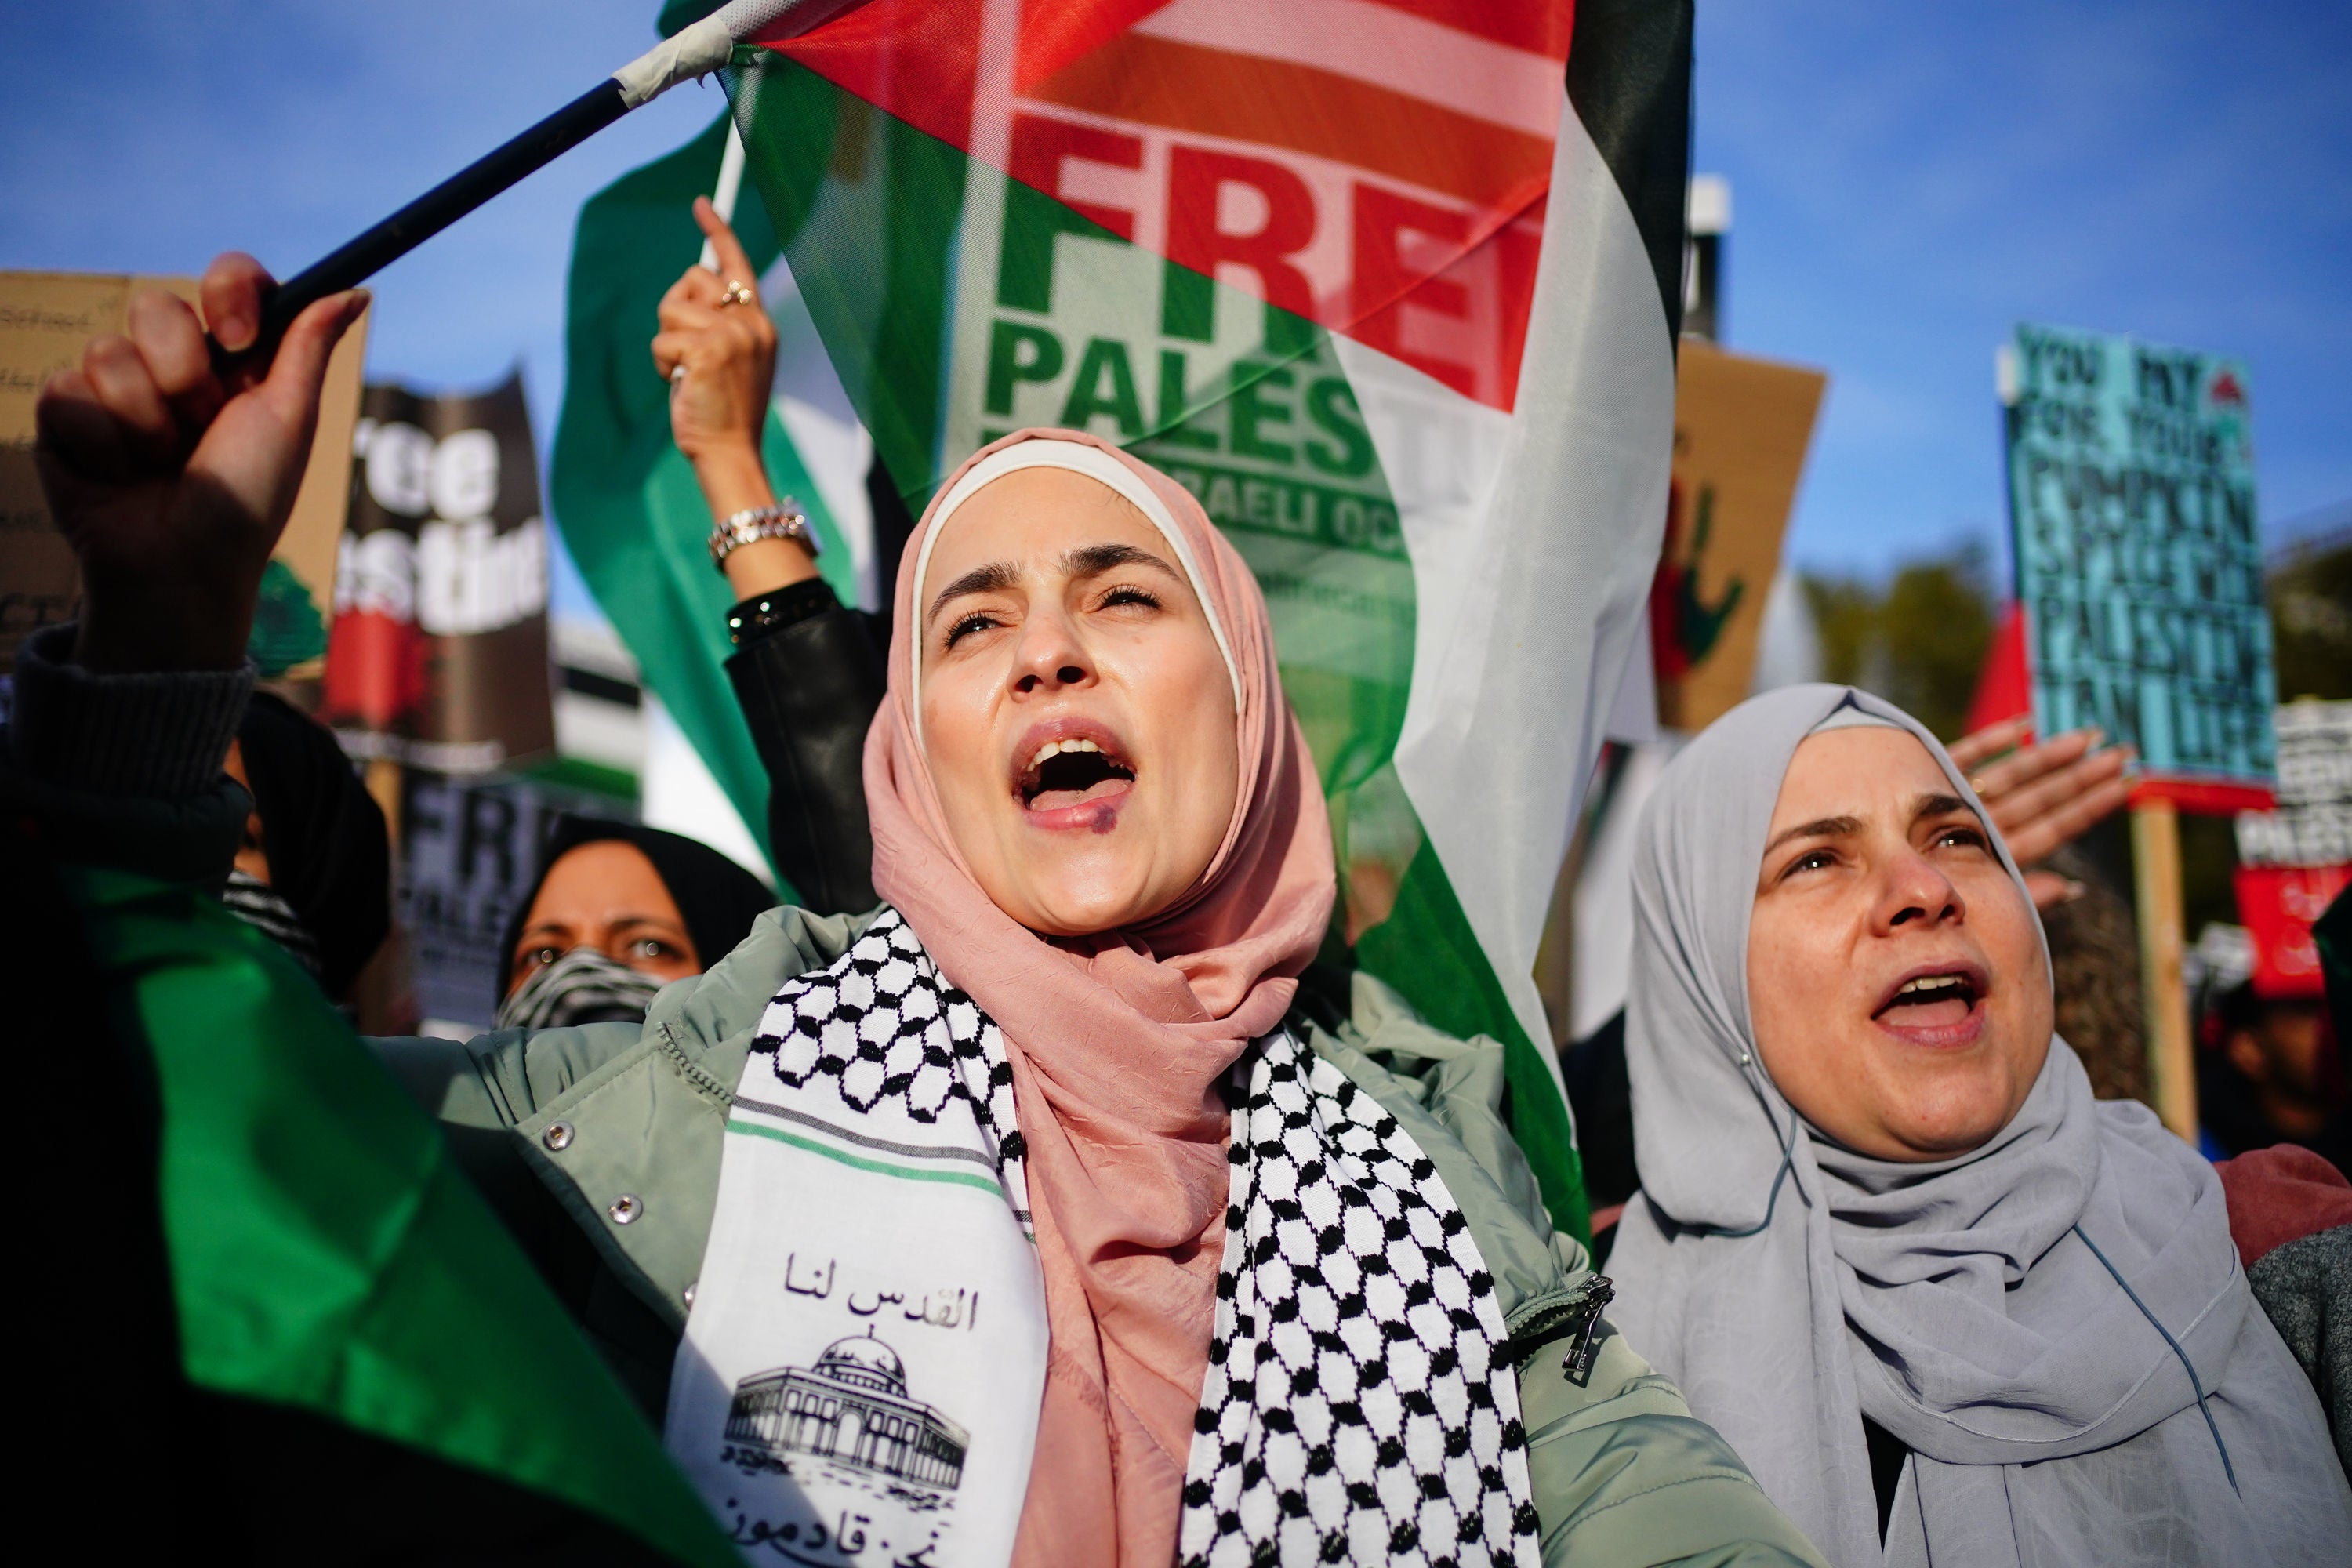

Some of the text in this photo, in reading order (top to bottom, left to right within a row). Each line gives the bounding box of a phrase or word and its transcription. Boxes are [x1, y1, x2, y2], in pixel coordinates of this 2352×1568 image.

[353, 419, 501, 520] ee
[784, 1251, 979, 1332] القدس لنا
